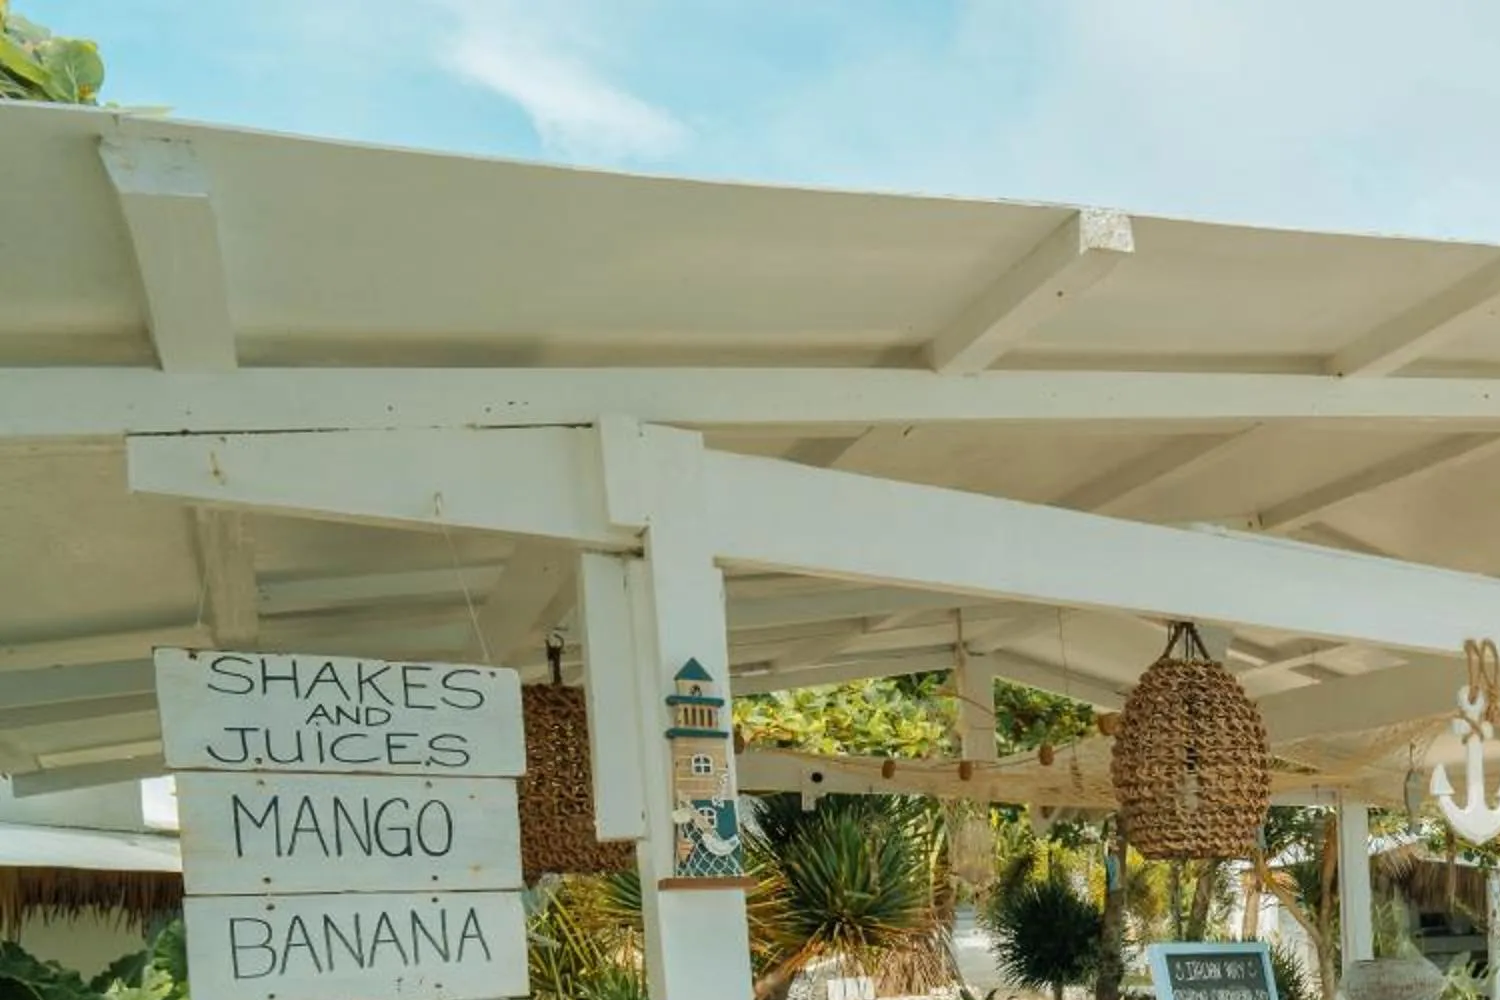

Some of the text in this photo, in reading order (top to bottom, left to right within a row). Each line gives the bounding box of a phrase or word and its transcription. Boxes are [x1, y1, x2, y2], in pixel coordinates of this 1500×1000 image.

[207, 655, 486, 711] SHAKES
[305, 703, 392, 727] AND
[206, 724, 471, 768] JUICES
[231, 794, 454, 858] MANGO
[229, 907, 492, 980] BANANA
